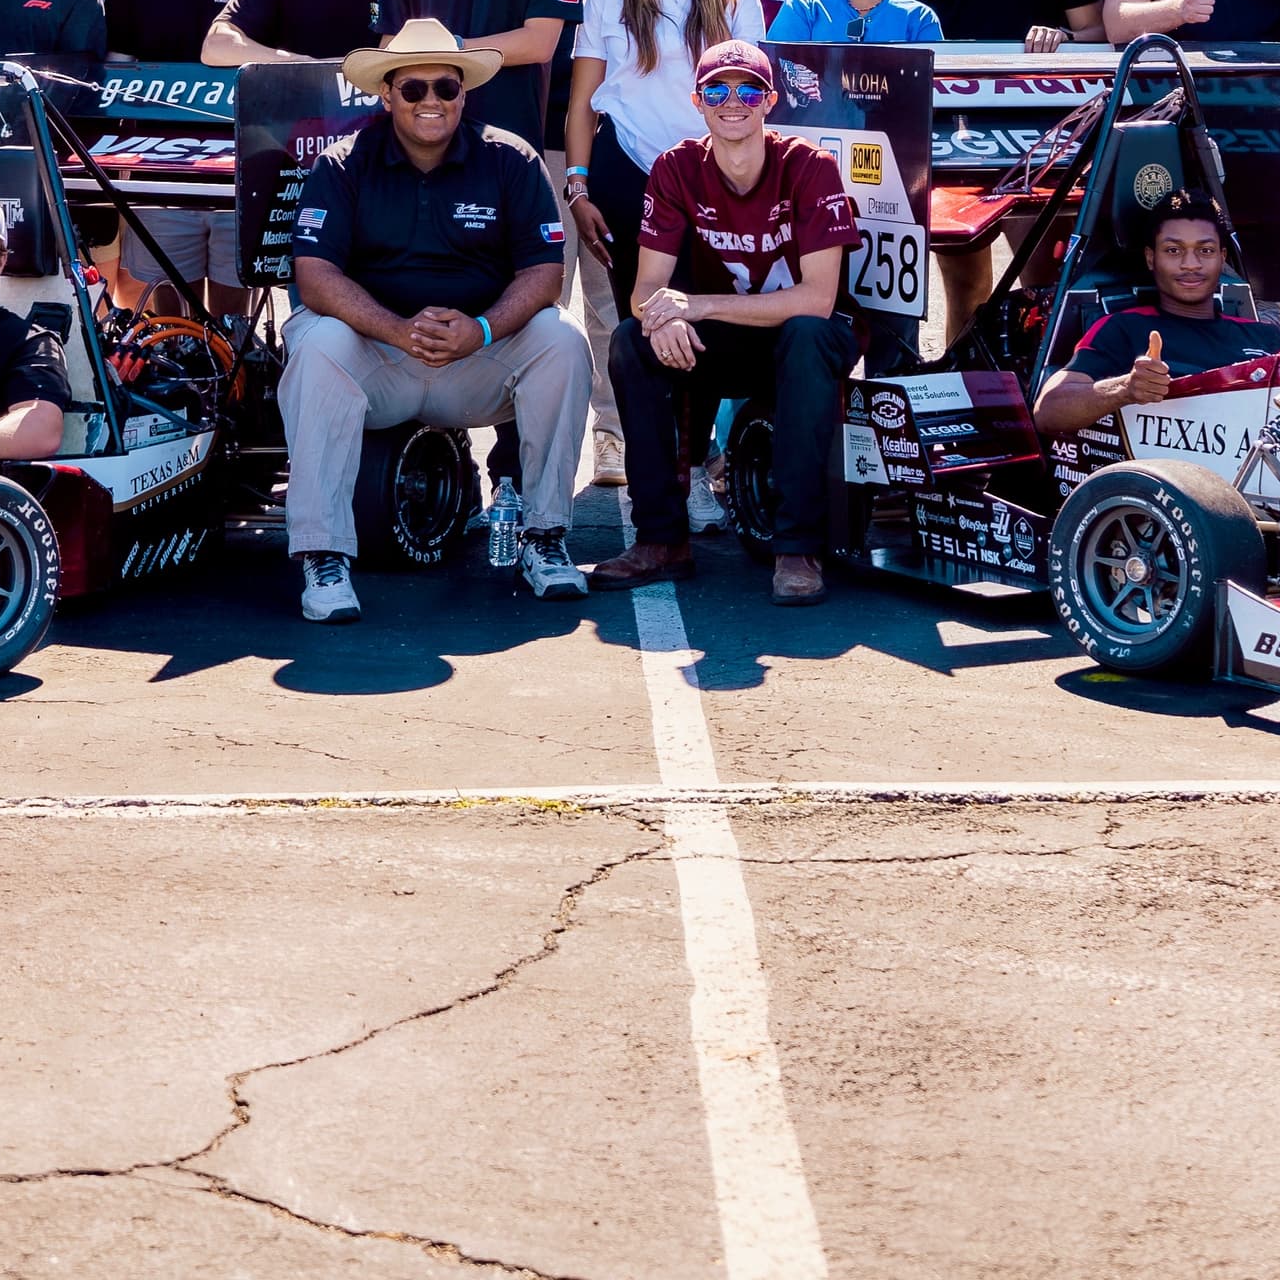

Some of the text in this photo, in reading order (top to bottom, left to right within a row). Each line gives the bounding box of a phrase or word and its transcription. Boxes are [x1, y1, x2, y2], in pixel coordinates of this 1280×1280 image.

[852, 147, 882, 171] ROMCO
[853, 228, 919, 303] 258
[925, 390, 960, 401] Solutions
[882, 435, 919, 458] Keating
[1136, 413, 1226, 455] TEXAS
[130, 445, 200, 495] TEXAS A&M
[132, 472, 203, 515] UNIVERSITY
[172, 528, 194, 566] NSK
[918, 530, 978, 561] TESLA
[980, 548, 1001, 566] NSK
